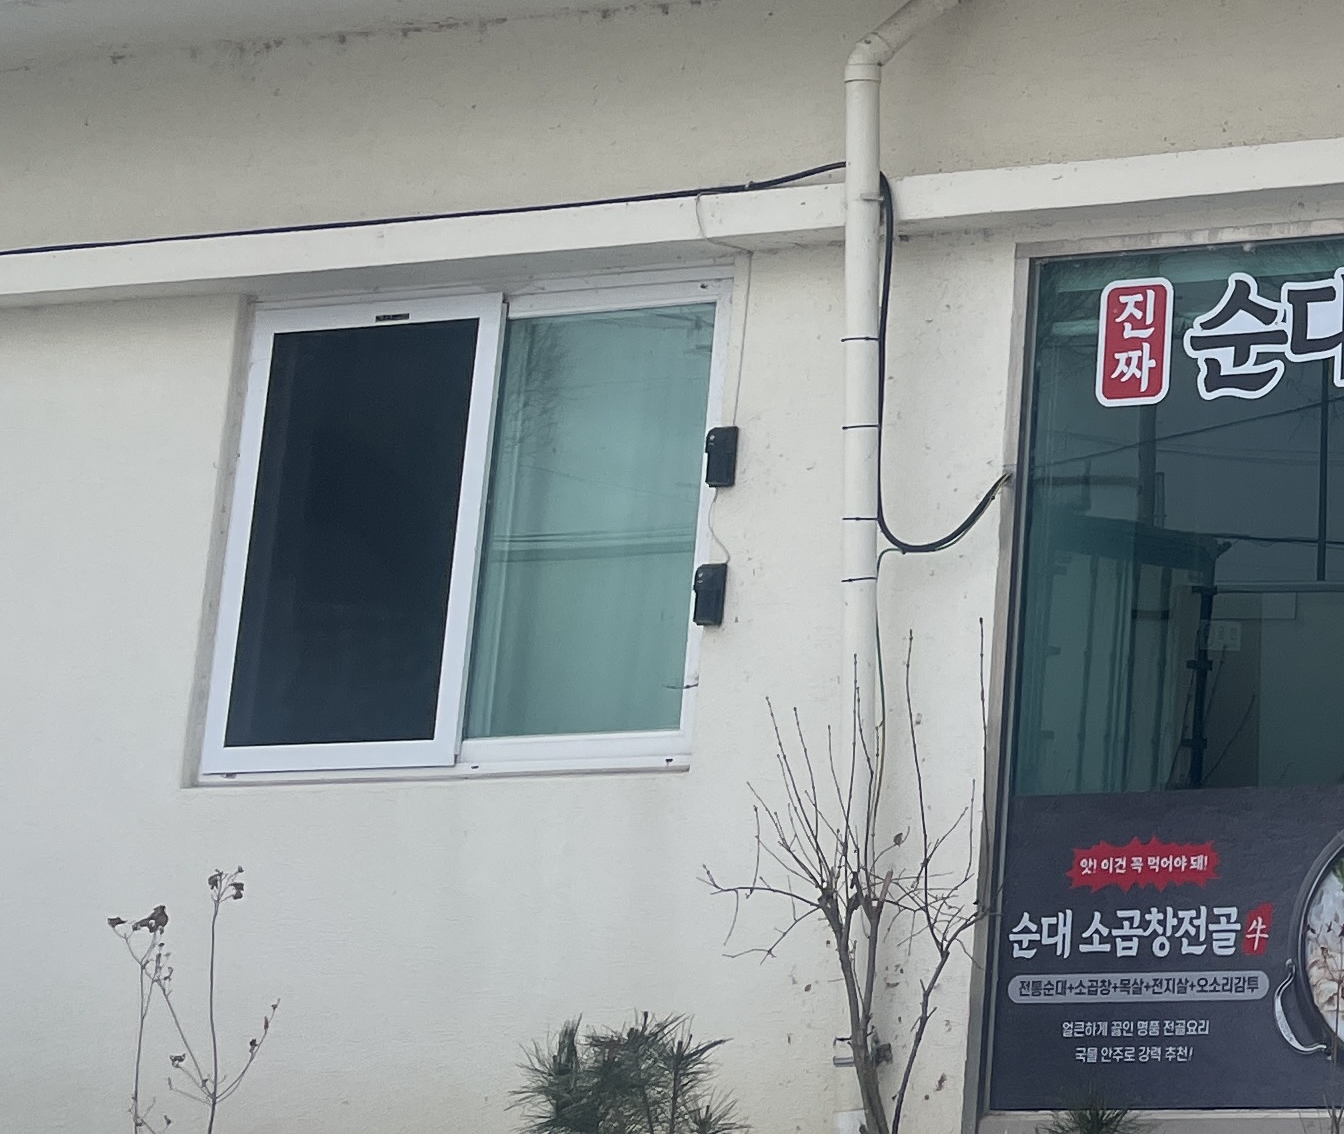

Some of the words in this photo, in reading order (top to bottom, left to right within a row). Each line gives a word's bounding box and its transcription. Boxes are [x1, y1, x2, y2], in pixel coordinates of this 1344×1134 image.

[1107, 288, 1161, 395] 진짜
[1100, 856, 1127, 875] 이건
[1130, 857, 1144, 873] 꼭
[1147, 855, 1188, 873] 먹어야
[1008, 908, 1073, 959] 순대
[1078, 905, 1242, 959] 소곱창전골
[1245, 915, 1270, 952] 牛
[1062, 1020, 1109, 1038] 얼큰하게
[1110, 1020, 1134, 1037] 끓인
[1137, 1020, 1160, 1036] 명품
[1163, 1019, 1210, 1036] 전골요리
[1074, 1047, 1098, 1063] 국물
[1100, 1047, 1136, 1063] 안주로
[1138, 1046, 1162, 1062] 강력
[1164, 1045, 1194, 1062] 추천!
